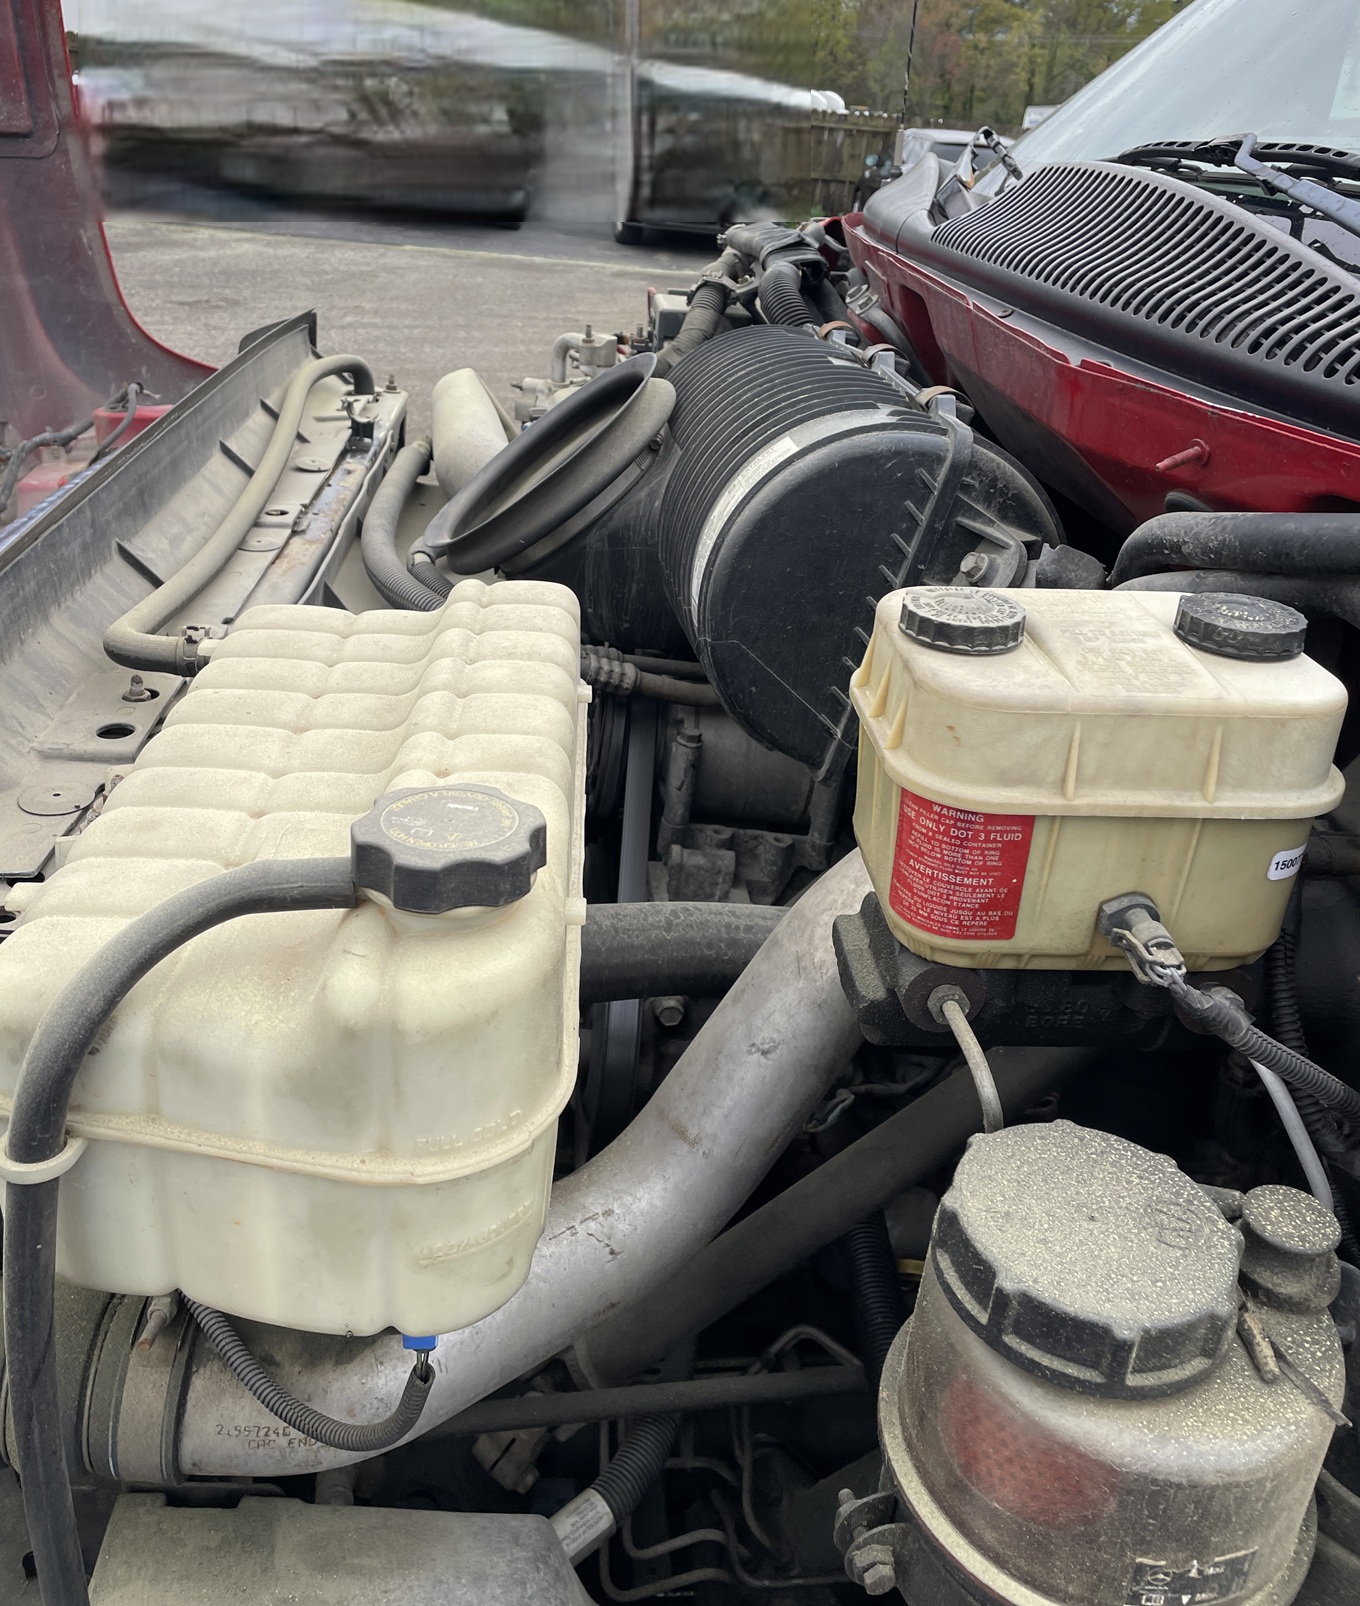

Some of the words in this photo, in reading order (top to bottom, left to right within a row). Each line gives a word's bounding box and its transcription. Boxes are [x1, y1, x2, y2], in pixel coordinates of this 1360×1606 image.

[932, 804, 984, 822] WARNING
[903, 804, 916, 820] USE
[920, 816, 946, 832] ONLY
[950, 828, 974, 838] DOT
[978, 832, 985, 840] 3
[990, 832, 1022, 840] FLUID
[956, 822, 984, 830] BEFORE
[934, 834, 960, 844] SEALED
[942, 843, 970, 854] BOTTOM
[920, 846, 941, 858] BELOW
[944, 856, 972, 864] BOTTOM
[942, 850, 962, 858] MORE
[909, 859, 994, 886] AVERTISSEMENT
[933, 880, 973, 892] COUVERCLE
[949, 894, 990, 904] PROVENANT
[956, 890, 995, 898] SEULEMENT
[922, 900, 948, 912] LIQUIDE
[930, 914, 948, 922] SOUS
[934, 910, 958, 920] NIVEAU
